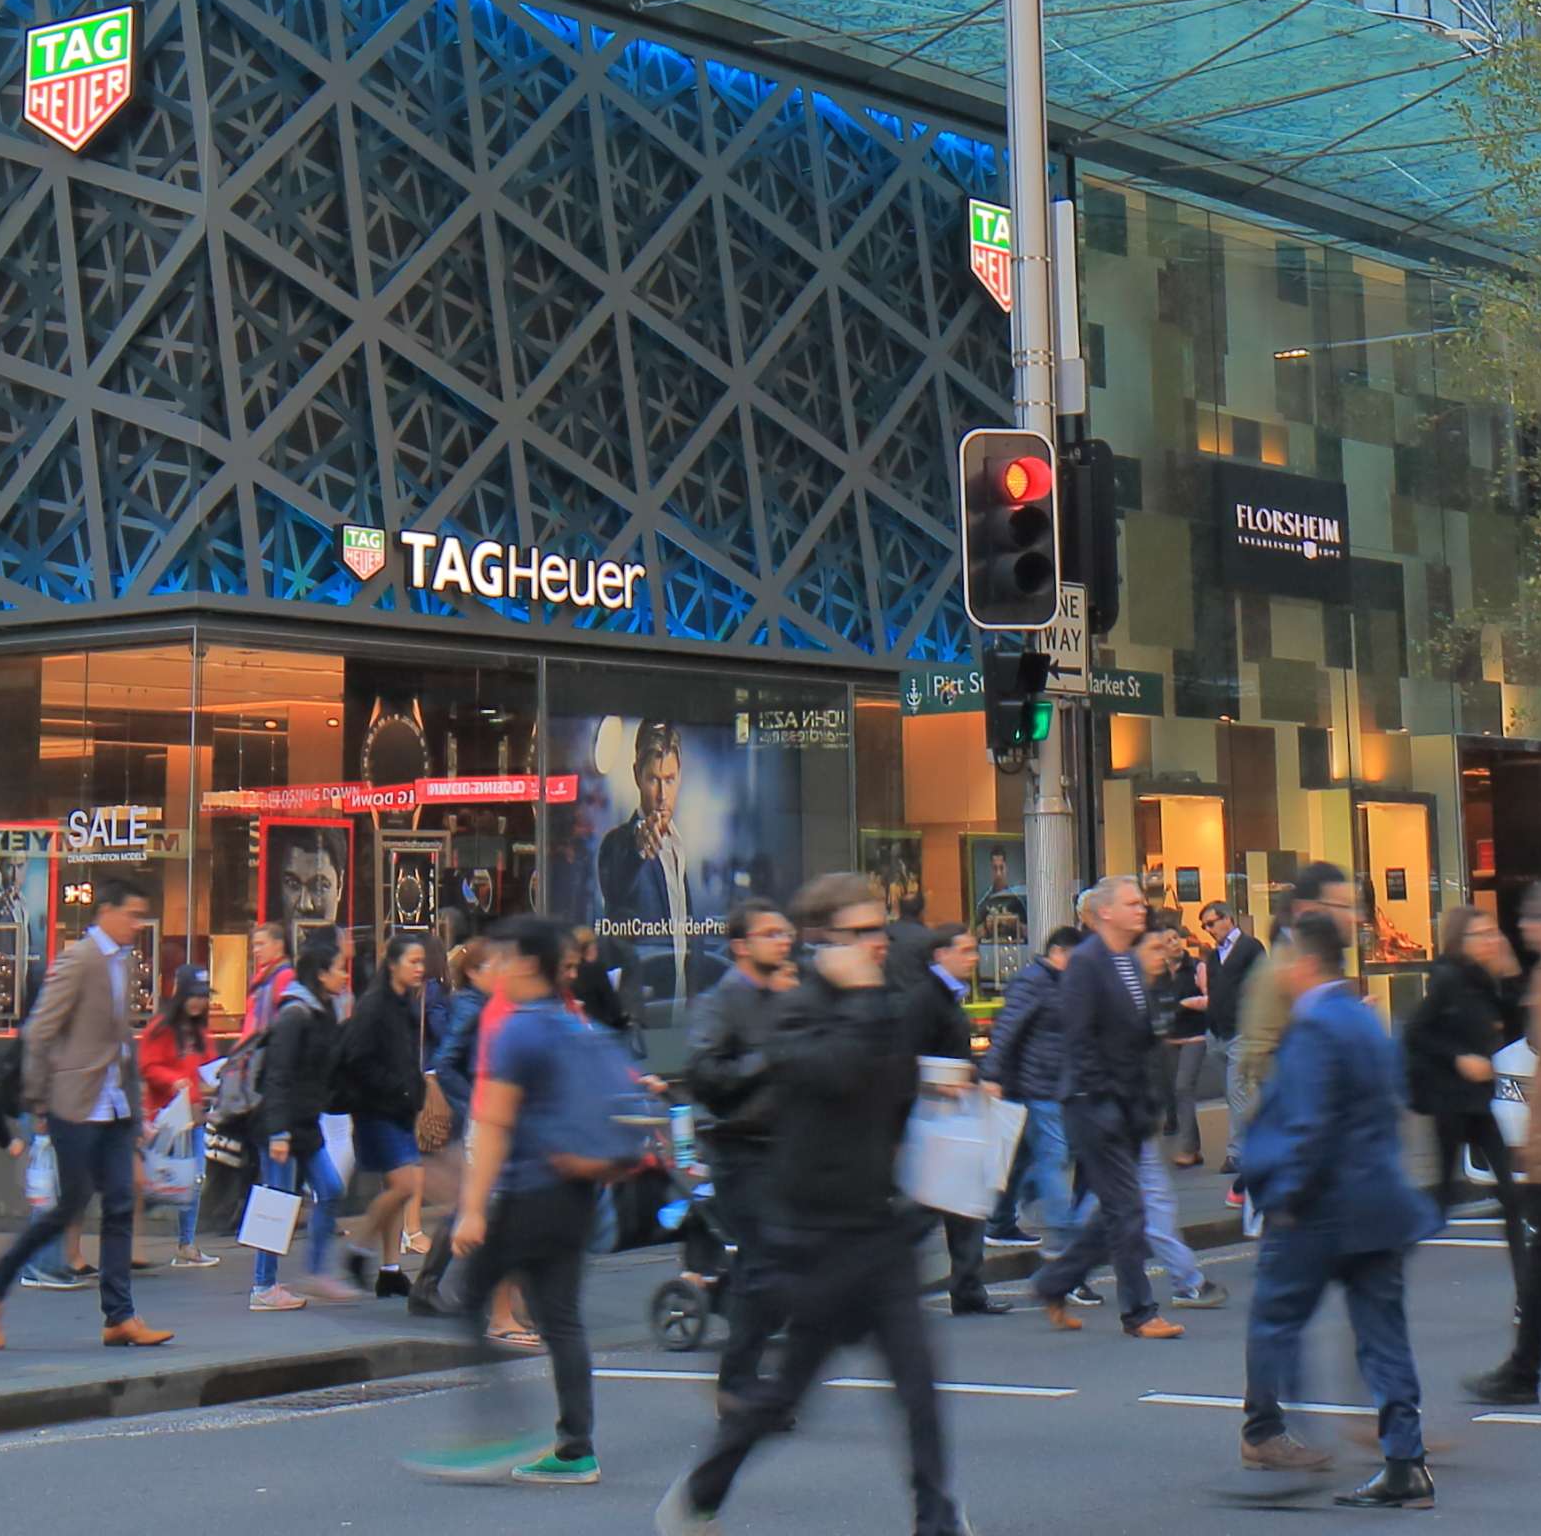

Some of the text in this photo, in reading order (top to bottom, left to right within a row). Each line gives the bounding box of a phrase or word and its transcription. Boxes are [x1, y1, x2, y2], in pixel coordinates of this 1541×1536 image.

[36, 19, 122, 73] TAG
[31, 69, 123, 138] HEUER
[975, 208, 1011, 243] TA
[975, 249, 1011, 302] HEU
[1236, 504, 1340, 544] FLORSHEIM
[348, 530, 380, 549] TAG
[346, 549, 381, 574] HEUER
[1059, 594, 1080, 618] NE
[1044, 626, 1082, 652] WAY
[1088, 671, 1141, 697] arket St
[68, 805, 148, 849] SALE
[67, 851, 147, 864] DEMONSTRATION MODELS
